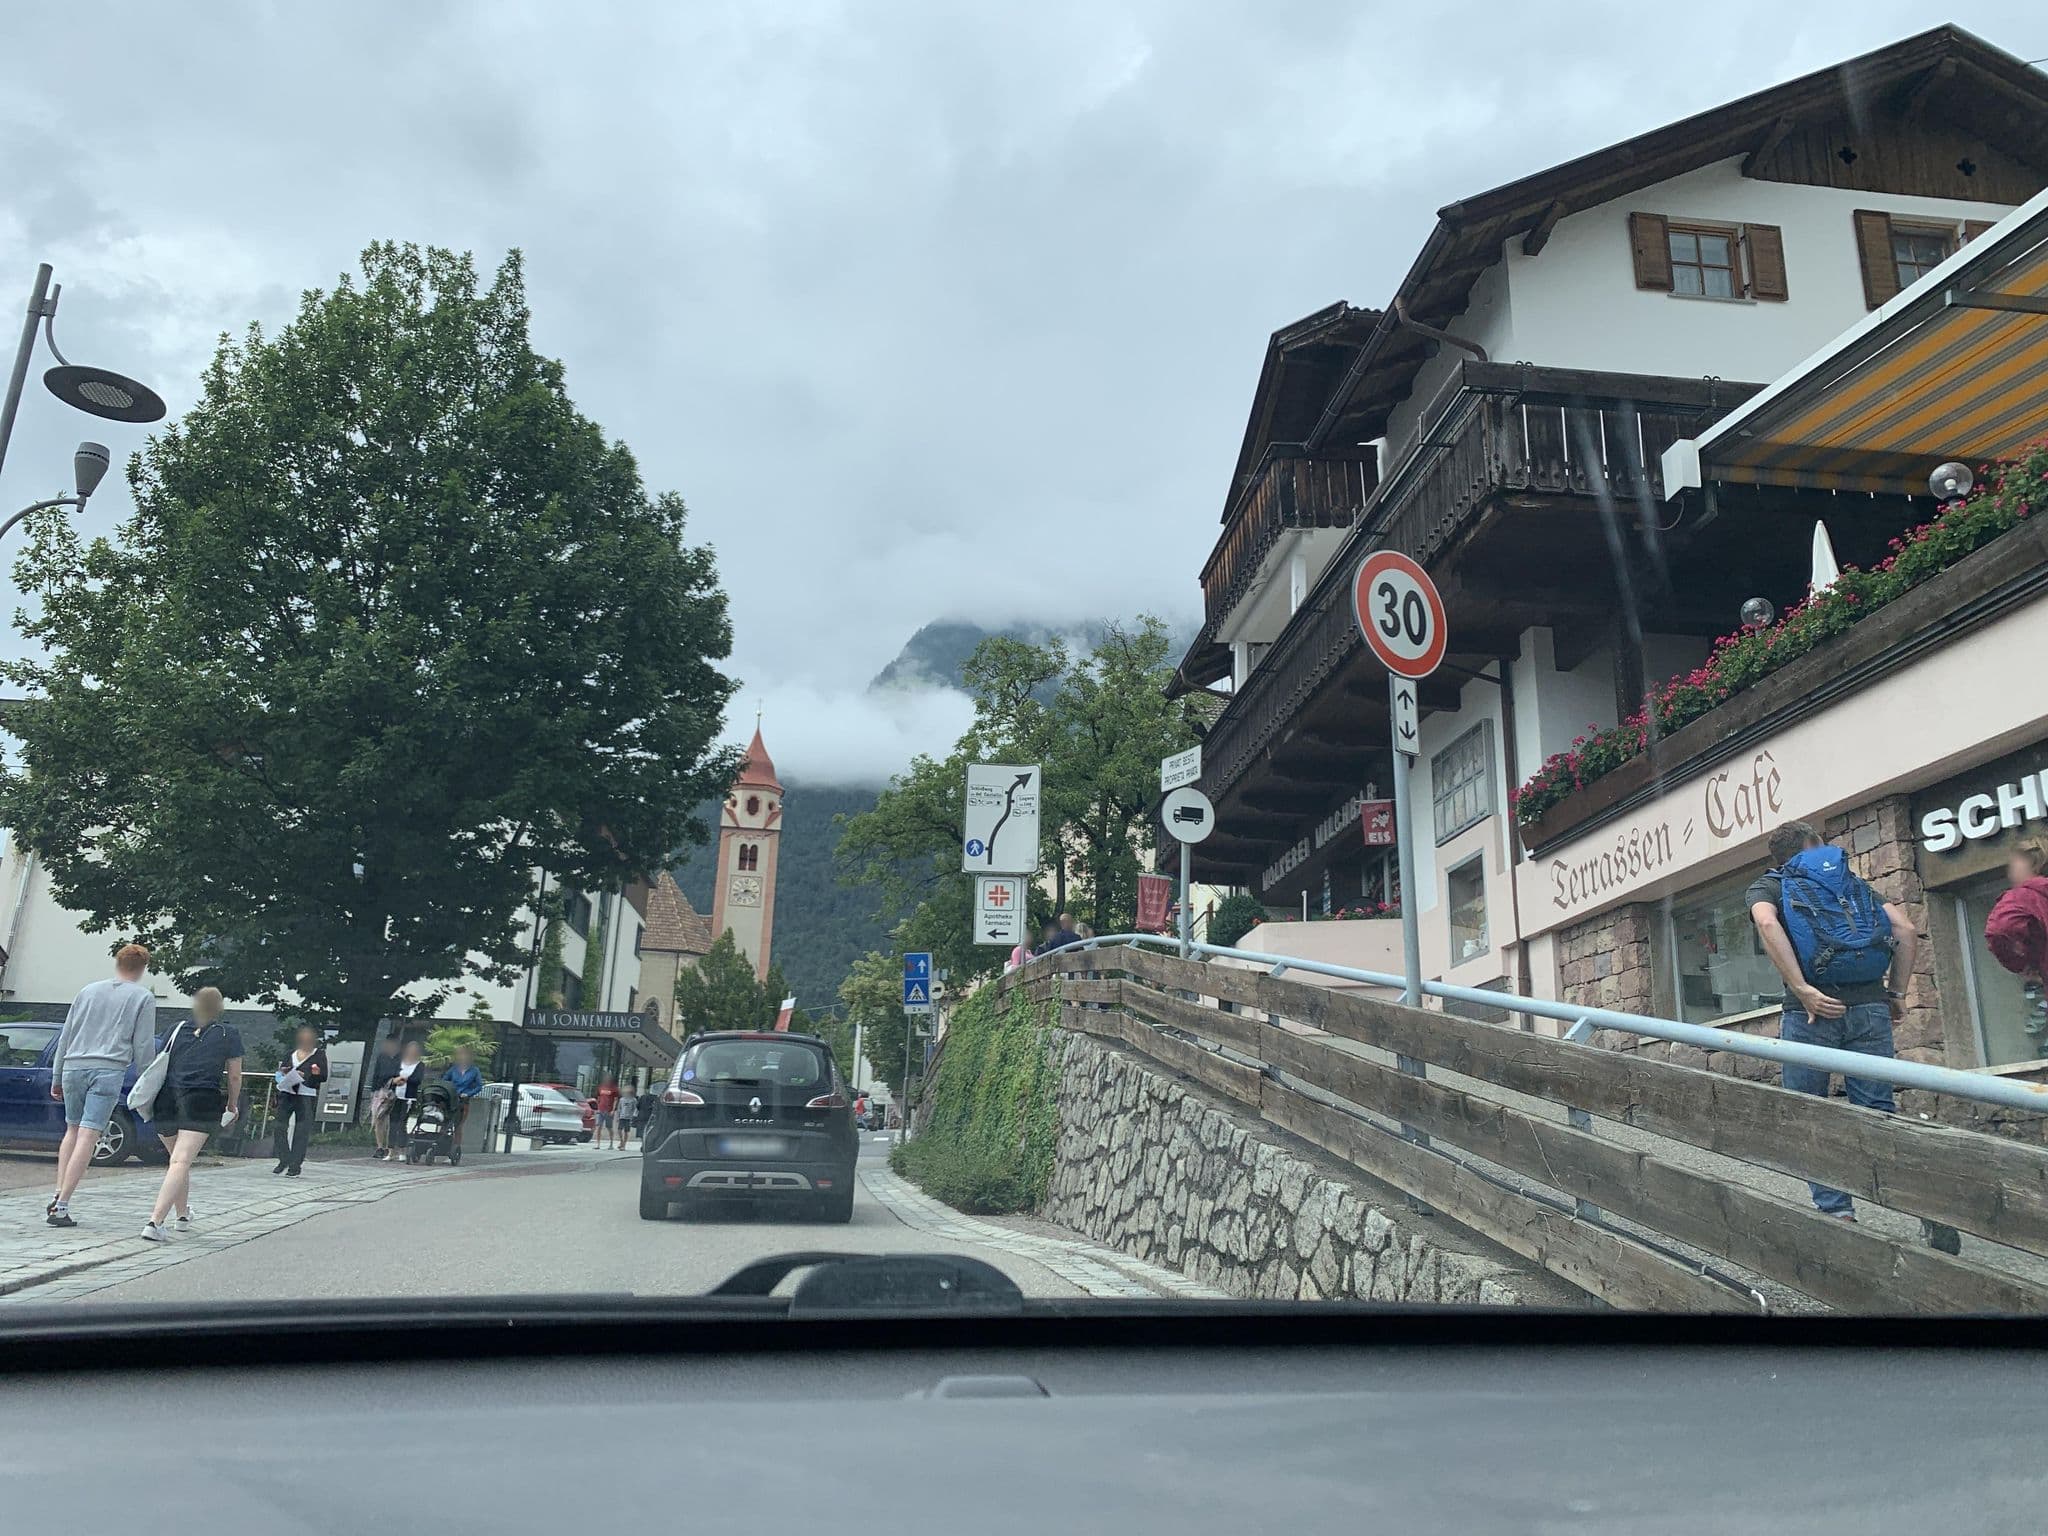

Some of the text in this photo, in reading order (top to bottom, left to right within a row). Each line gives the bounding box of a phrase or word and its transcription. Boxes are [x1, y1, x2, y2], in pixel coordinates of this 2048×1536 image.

[1377, 581, 1428, 646] 30
[1368, 831, 1391, 843] EIS
[1921, 768, 2048, 853] SCH
[1551, 821, 1674, 910] Terrassen
[530, 1012, 641, 1029] AM SONNENHANG
